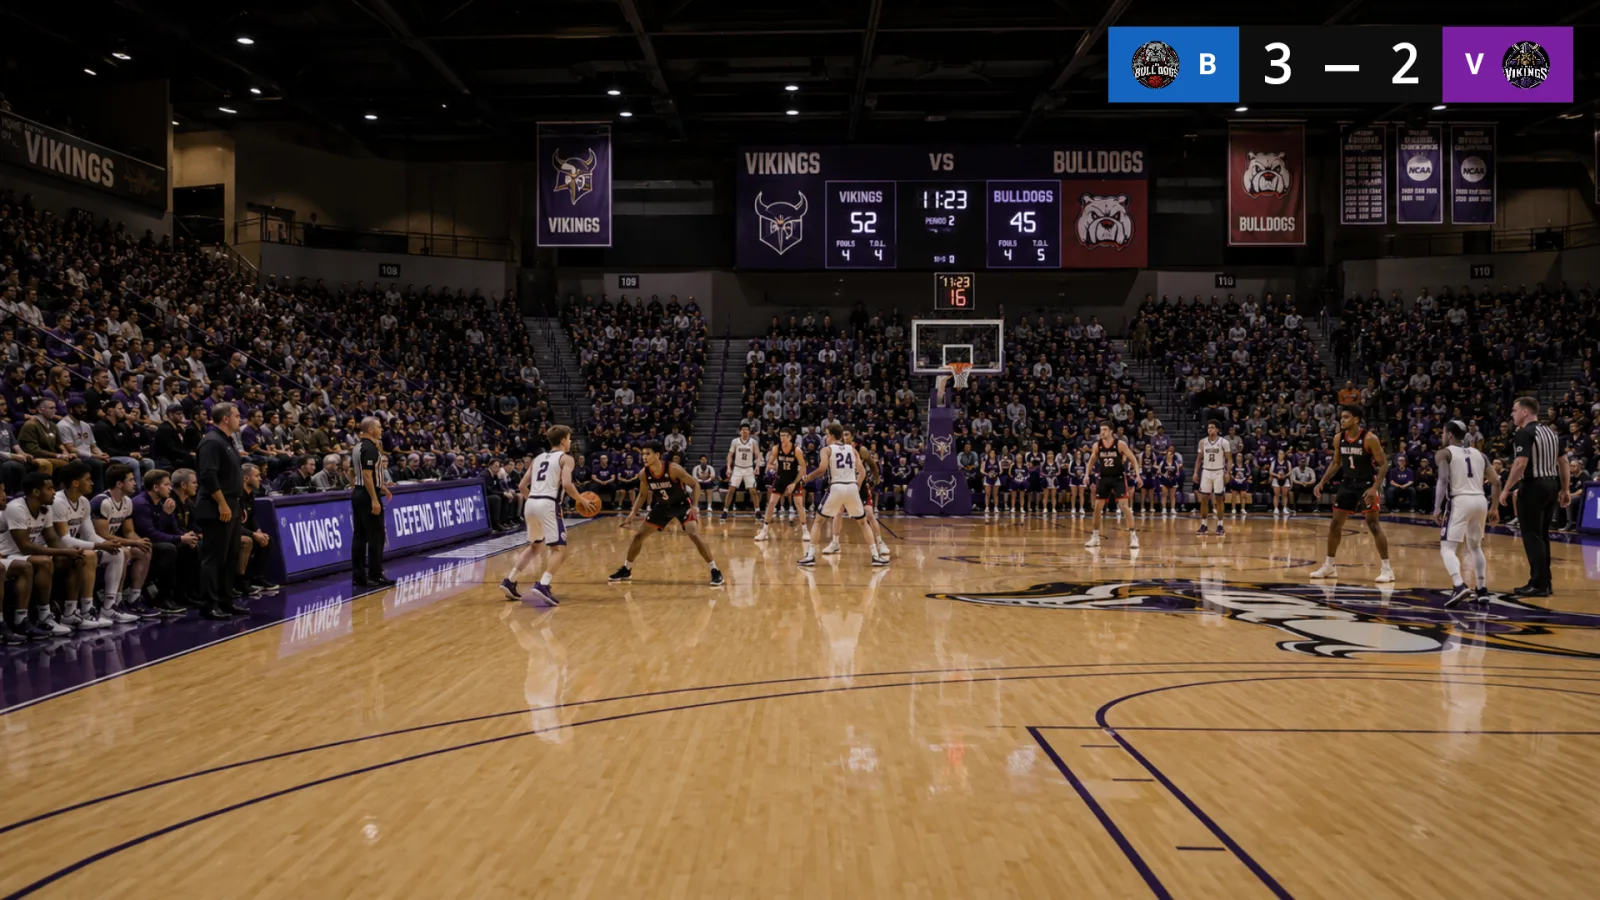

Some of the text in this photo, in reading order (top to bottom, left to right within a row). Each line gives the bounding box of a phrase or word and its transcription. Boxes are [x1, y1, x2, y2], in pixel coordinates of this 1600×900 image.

[24, 130, 115, 188] VIKINGS
[745, 151, 821, 175] VIKINGS
[928, 153, 955, 171] VS
[1053, 150, 1144, 174] BULLDOGS
[839, 190, 883, 203] VIKINGS
[923, 189, 968, 209] 11:23
[993, 190, 1054, 203] BULLDOGS
[548, 216, 600, 233] VIKINGS
[850, 211, 877, 233] 52
[948, 214, 955, 226] 2
[1009, 211, 1037, 233] 45
[1239, 215, 1296, 232] BULLDOGS
[998, 239, 1018, 247] FOULS
[841, 249, 851, 261] 4
[874, 249, 883, 261] 4
[1003, 249, 1013, 261] 4
[1036, 249, 1046, 262] 5
[381, 265, 398, 276] 108
[1473, 266, 1491, 277] 110
[621, 277, 636, 287] 109
[943, 276, 971, 288] 11:23
[950, 289, 967, 307] 16
[835, 452, 853, 469] 24
[1103, 458, 1115, 467] 22
[1348, 455, 1355, 470] 1
[1465, 457, 1473, 478] 1
[536, 461, 549, 481] 2
[660, 489, 669, 501] 3
[393, 503, 434, 537] DEFEND
[434, 499, 455, 528] THE
[454, 497, 474, 525] SHIP
[289, 516, 343, 556] VIKINGS
